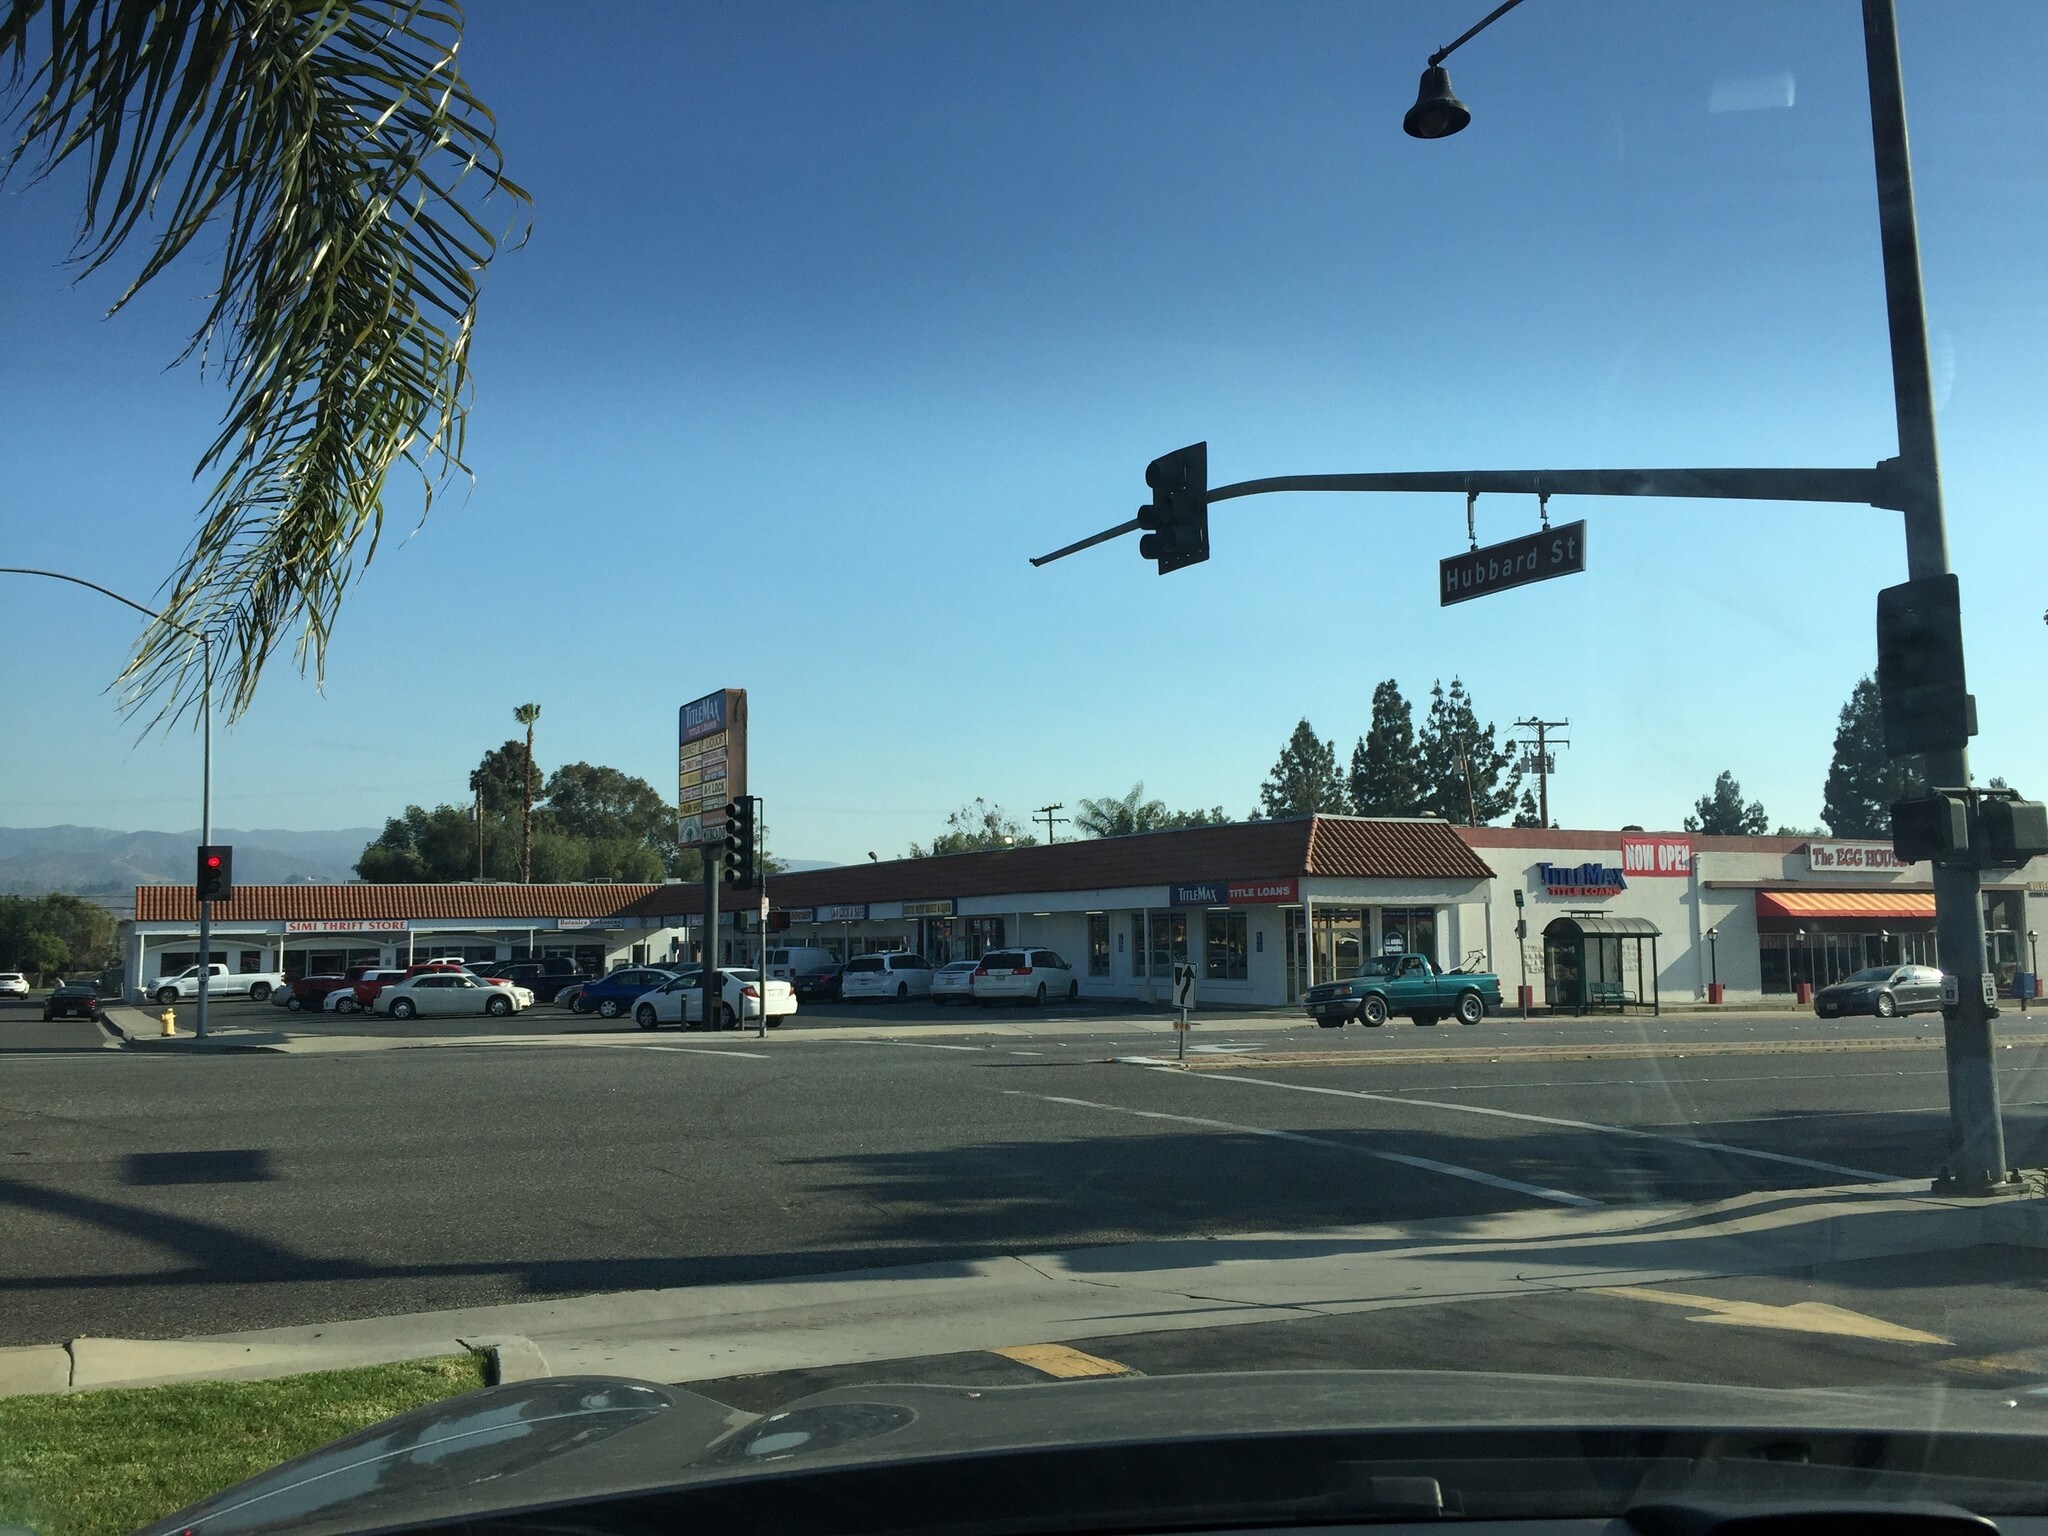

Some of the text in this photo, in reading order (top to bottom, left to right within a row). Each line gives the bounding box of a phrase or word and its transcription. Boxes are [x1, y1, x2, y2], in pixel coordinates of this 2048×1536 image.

[1446, 536, 1576, 592] Hubbard St
[711, 781, 725, 794] LOCK
[1625, 844, 1690, 871] NOW OPEN
[1813, 848, 1908, 868] The EGG HOUS
[1229, 888, 1255, 898] TITLE
[1257, 886, 1290, 897] LOANS
[1548, 886, 1622, 897] TITLE LOANS
[289, 921, 406, 931] SIMI THRIFT STORE
